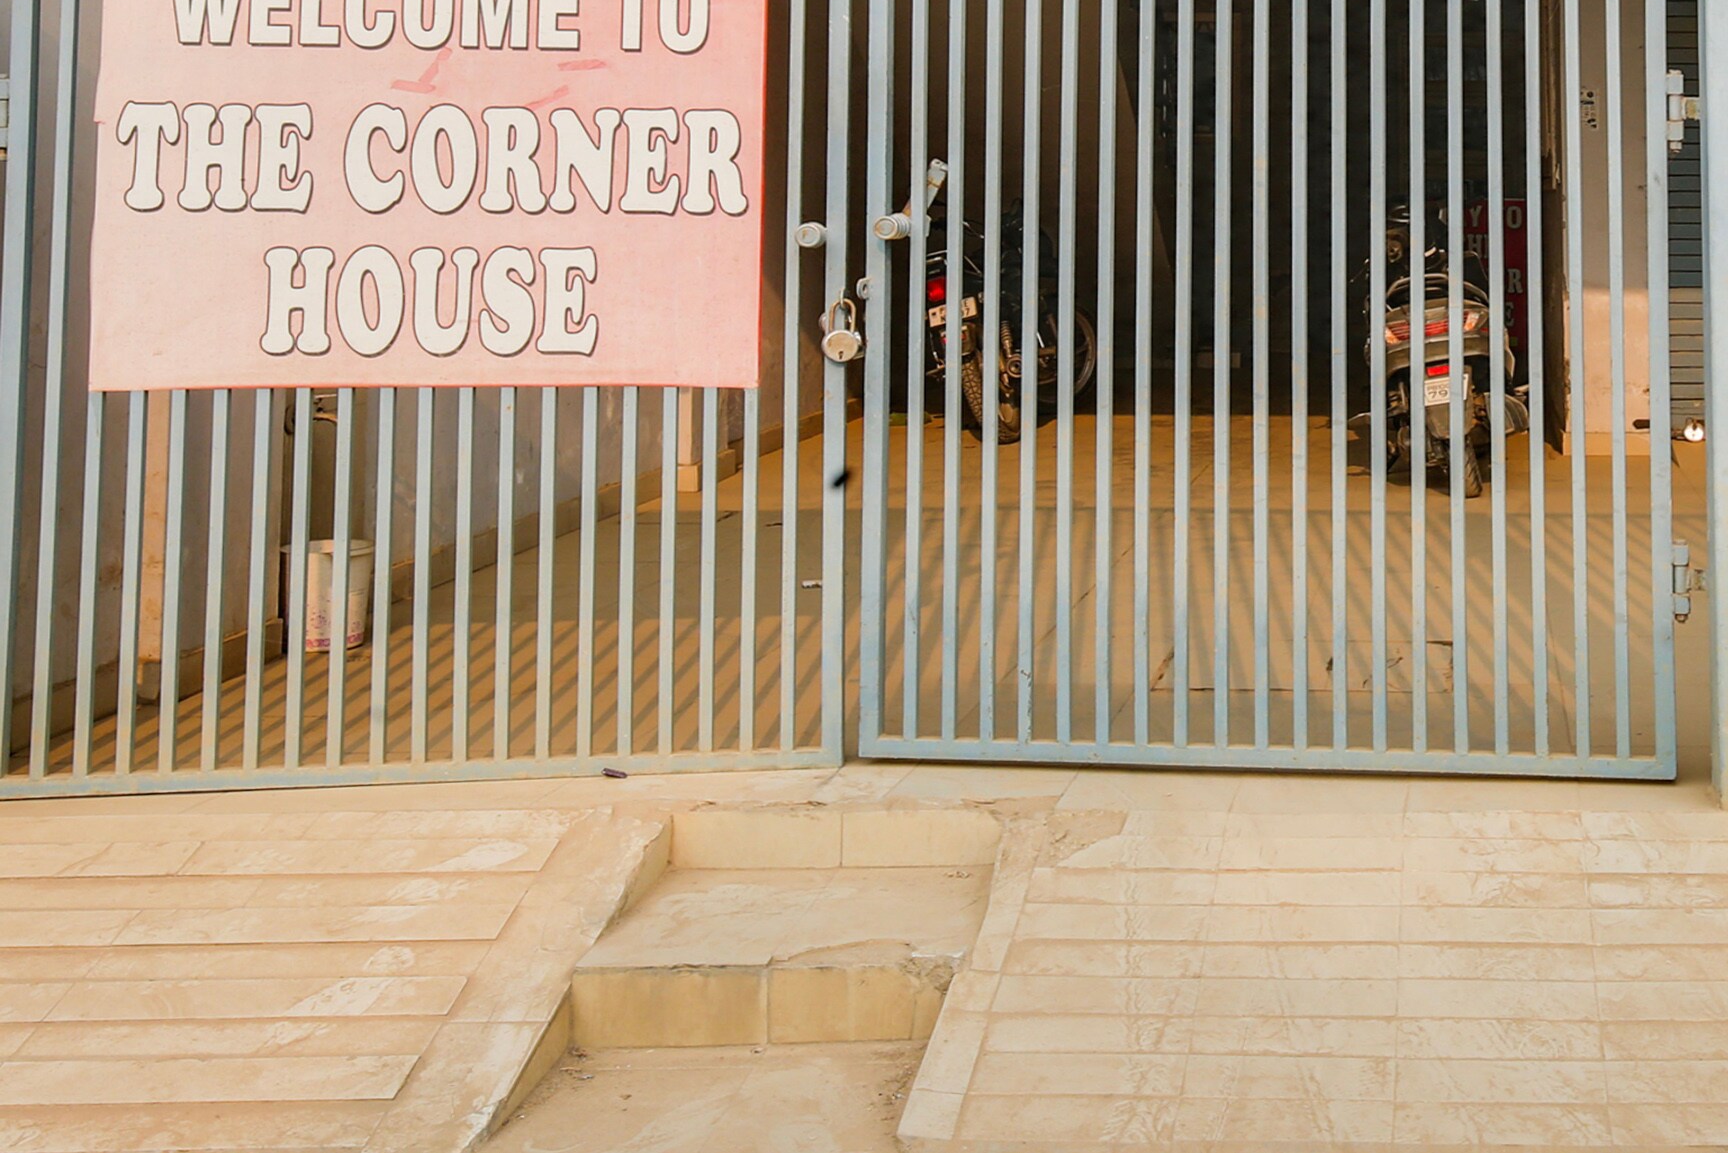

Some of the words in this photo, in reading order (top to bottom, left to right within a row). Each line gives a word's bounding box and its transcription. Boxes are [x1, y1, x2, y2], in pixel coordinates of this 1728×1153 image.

[116, 100, 313, 214] THE
[343, 101, 748, 216] CORNER
[260, 244, 599, 358] HOUSE
